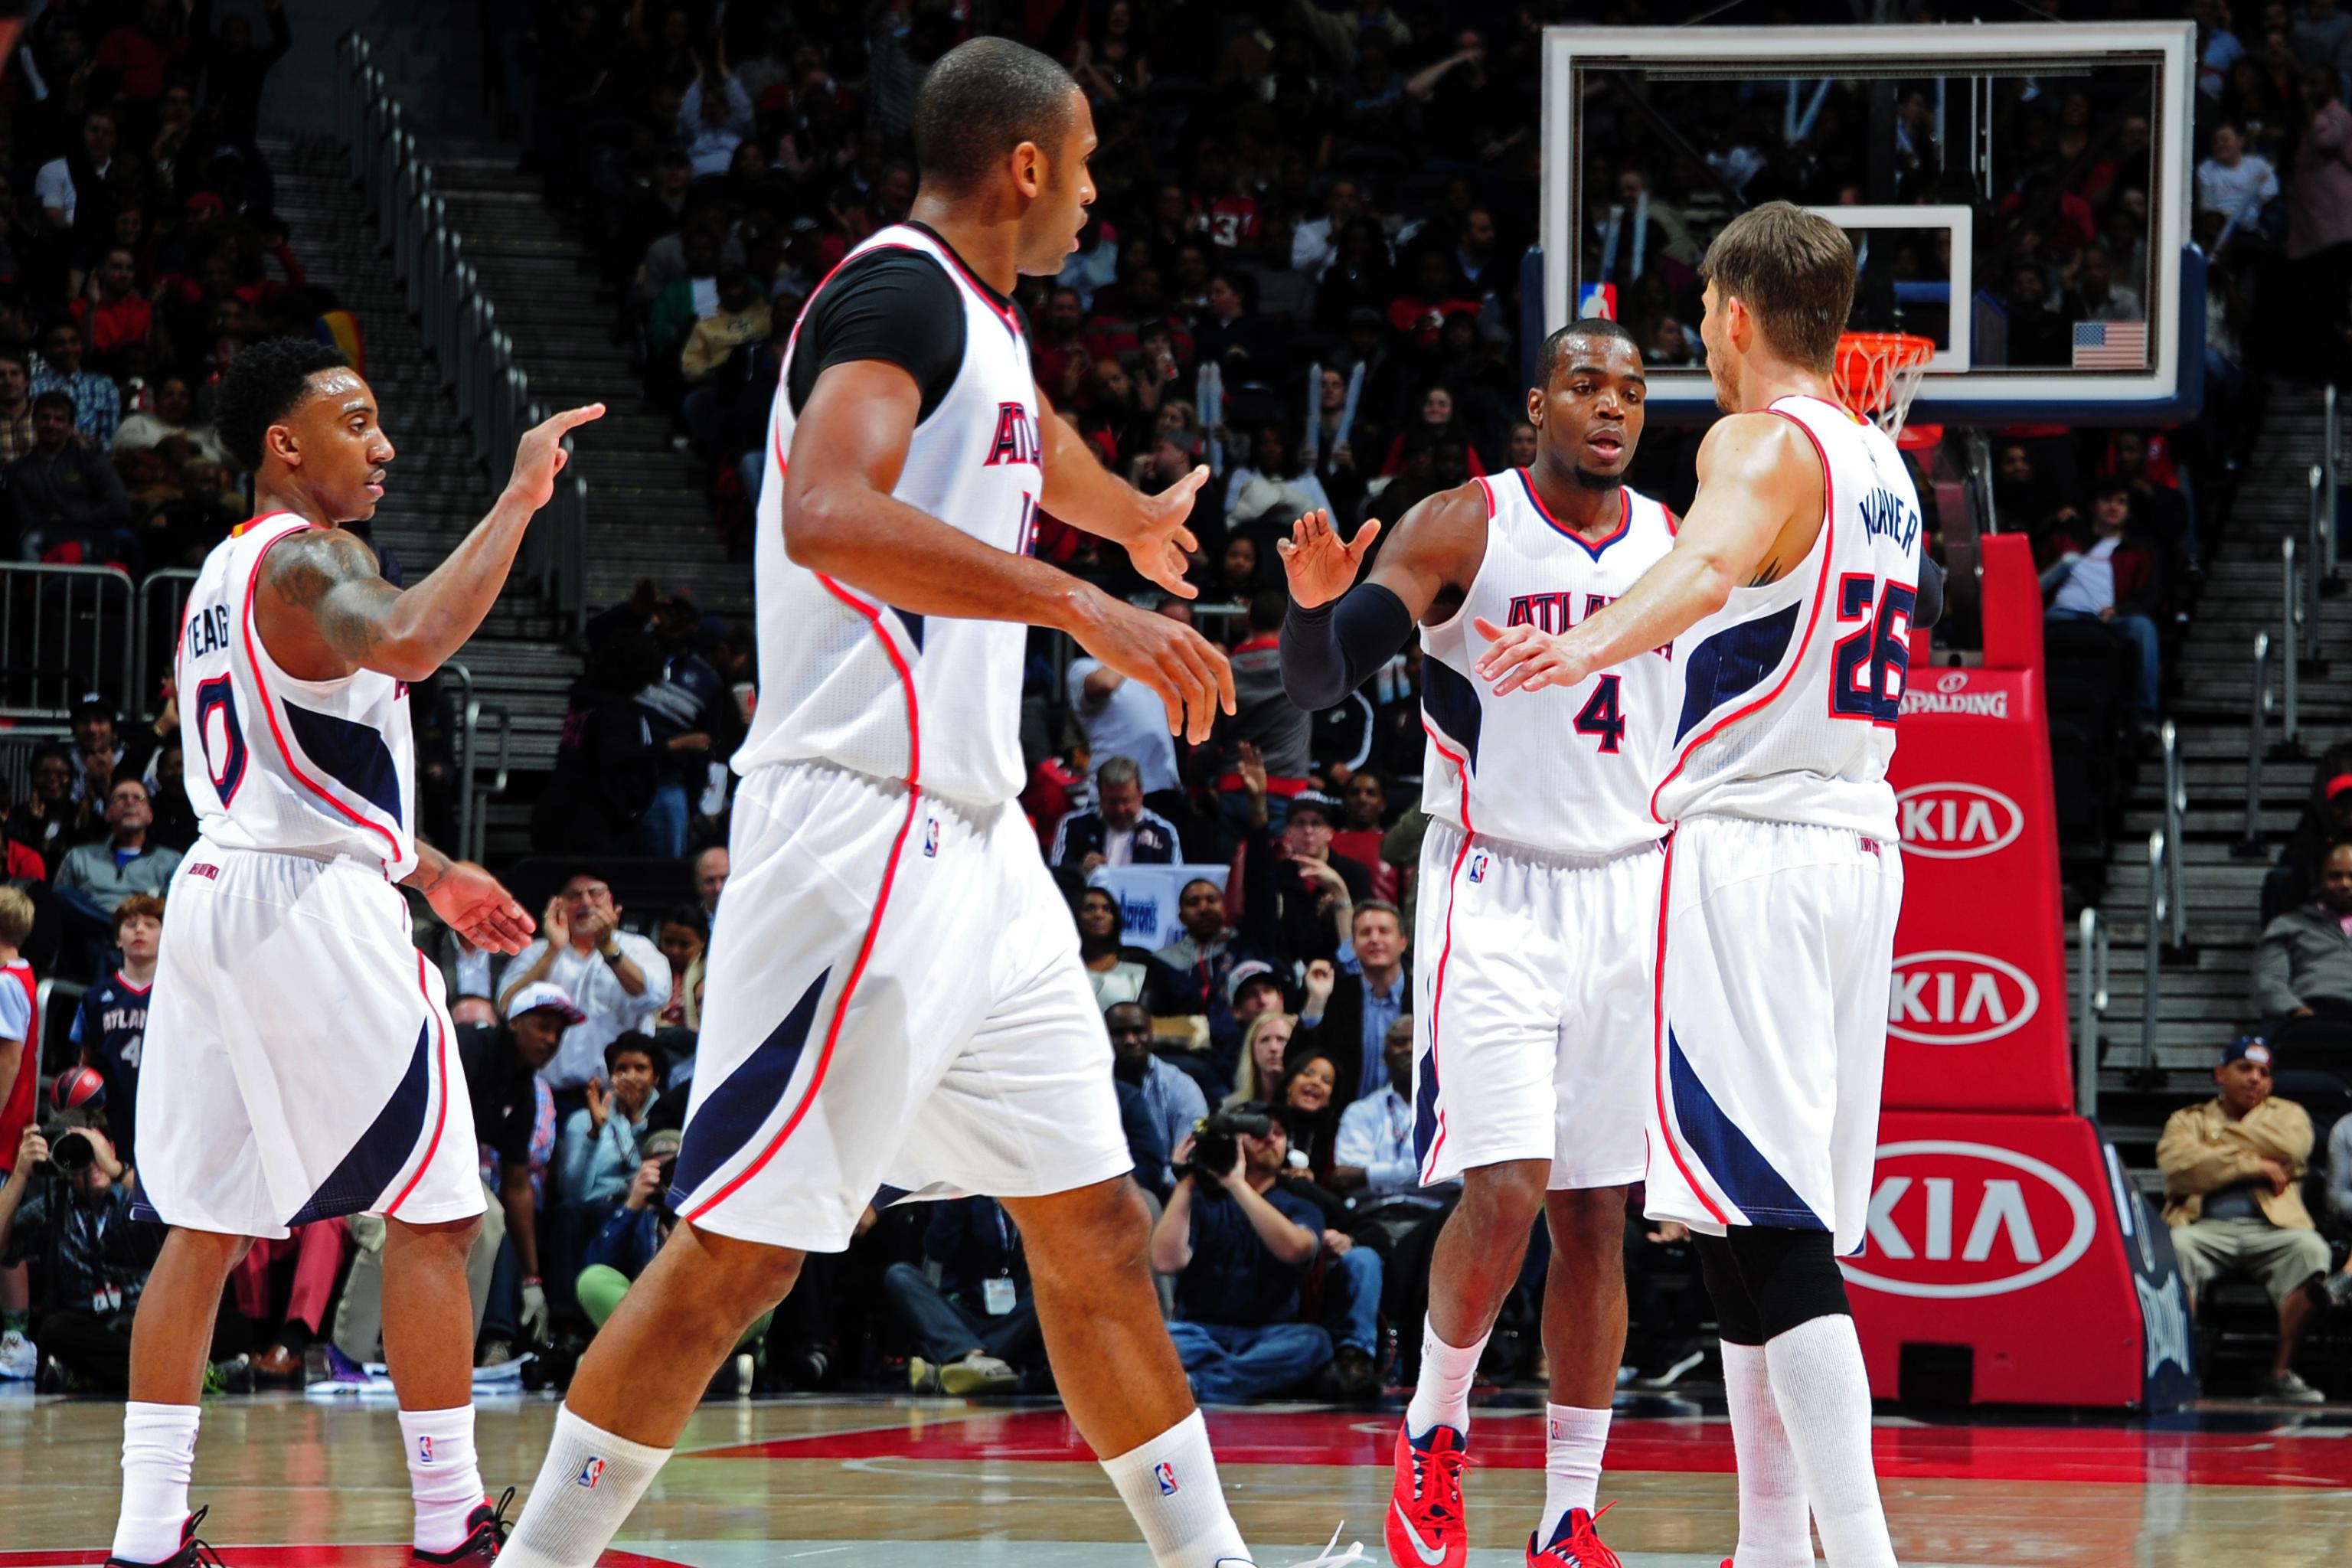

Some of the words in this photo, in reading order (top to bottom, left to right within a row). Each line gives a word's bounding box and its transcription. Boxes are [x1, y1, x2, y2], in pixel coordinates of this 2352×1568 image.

[1828, 572, 1918, 730] 26
[1573, 674, 1626, 754] 4
[1898, 688, 2008, 719] SPALDING
[196, 671, 248, 810] 0
[1902, 800, 2000, 841] KIA
[1889, 972, 2008, 1024] KIA
[120, 1034, 142, 1069] 4
[1844, 1177, 2043, 1263] KIA
